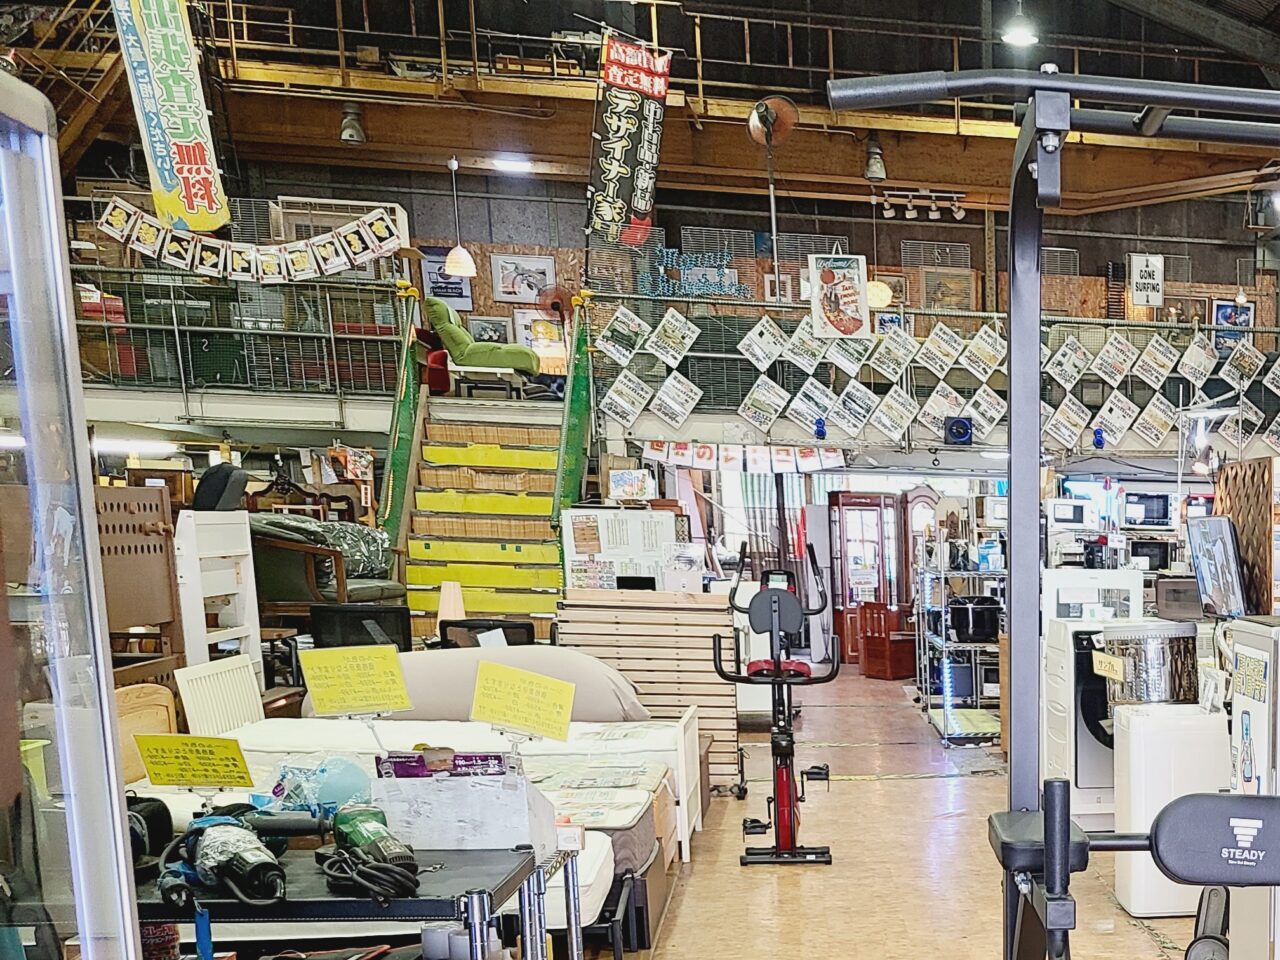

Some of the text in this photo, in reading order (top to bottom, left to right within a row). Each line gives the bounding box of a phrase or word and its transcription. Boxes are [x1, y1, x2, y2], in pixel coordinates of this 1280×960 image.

[1140, 269, 1155, 280] GONE
[1135, 282, 1160, 293] SURFING
[1221, 848, 1266, 860] STEADY
